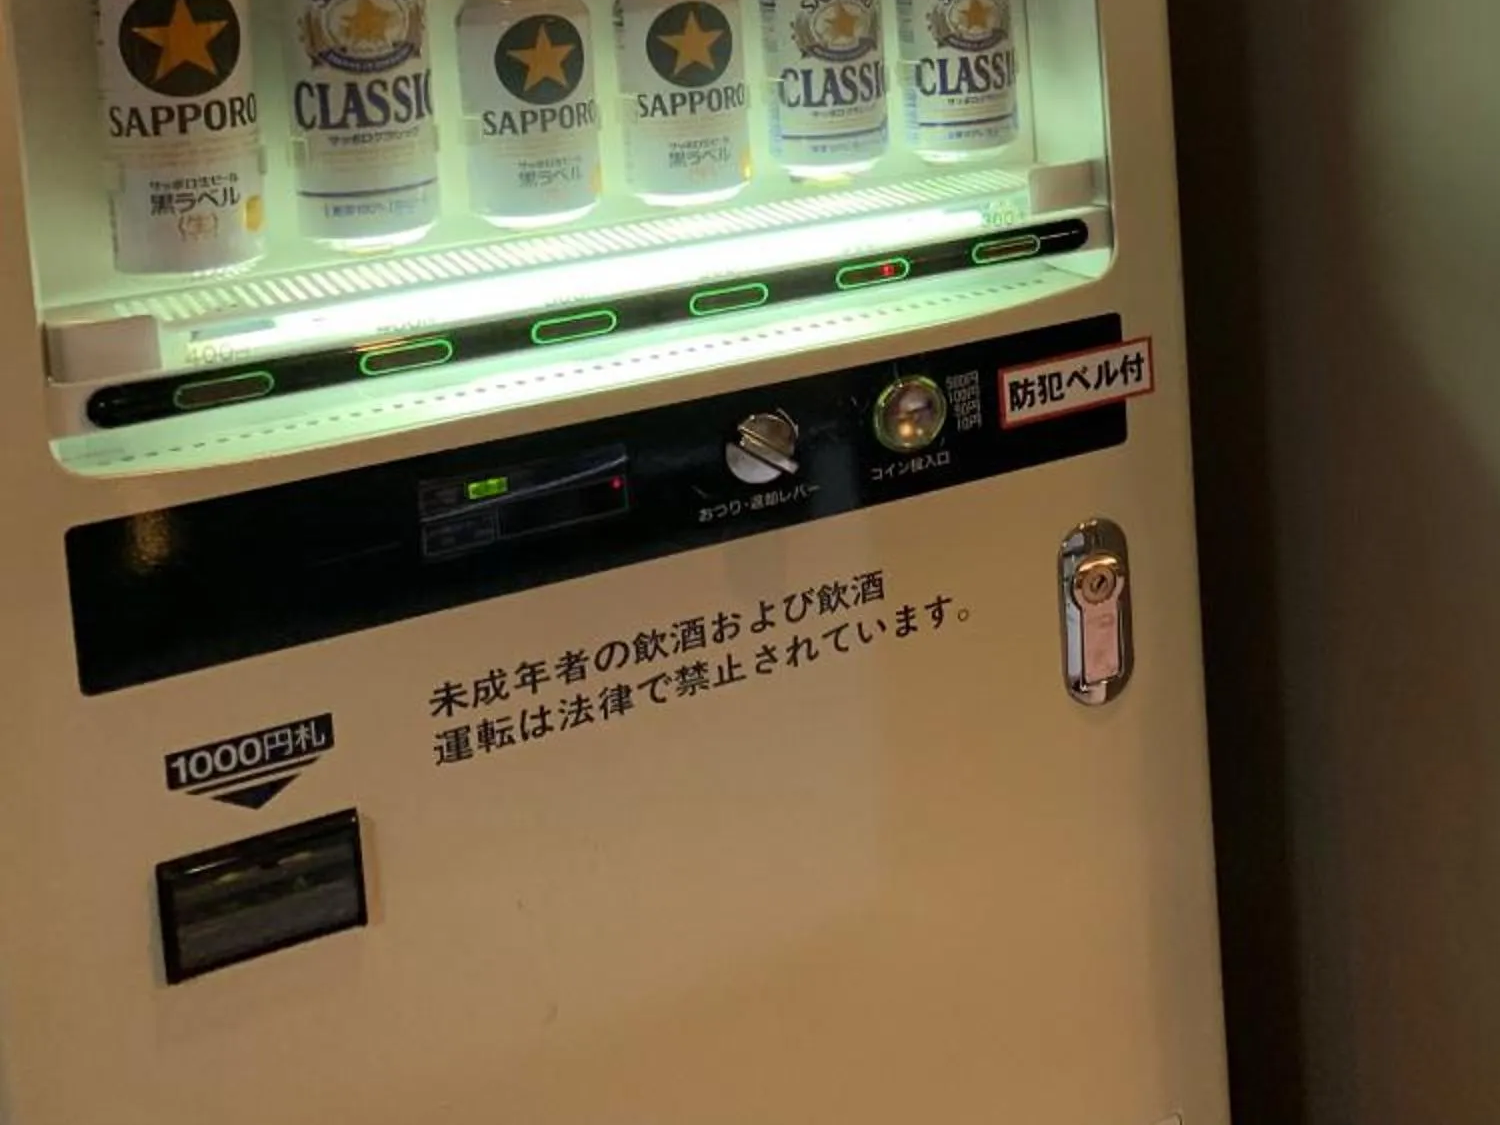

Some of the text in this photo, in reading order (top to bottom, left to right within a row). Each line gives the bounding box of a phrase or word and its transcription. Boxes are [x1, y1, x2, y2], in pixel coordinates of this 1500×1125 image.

[109, 92, 257, 137] SAPPORO
[637, 83, 745, 118] SAPPORO
[151, 187, 241, 216] 黒ラベル
[1008, 354, 1144, 412] 防犯ベル付
[871, 450, 951, 481] コイン投入口
[429, 570, 886, 718] 未成年者の飲酒および飲酒
[434, 595, 971, 766] 運転は法律で禁止されています。
[170, 720, 327, 784] 1000円札
